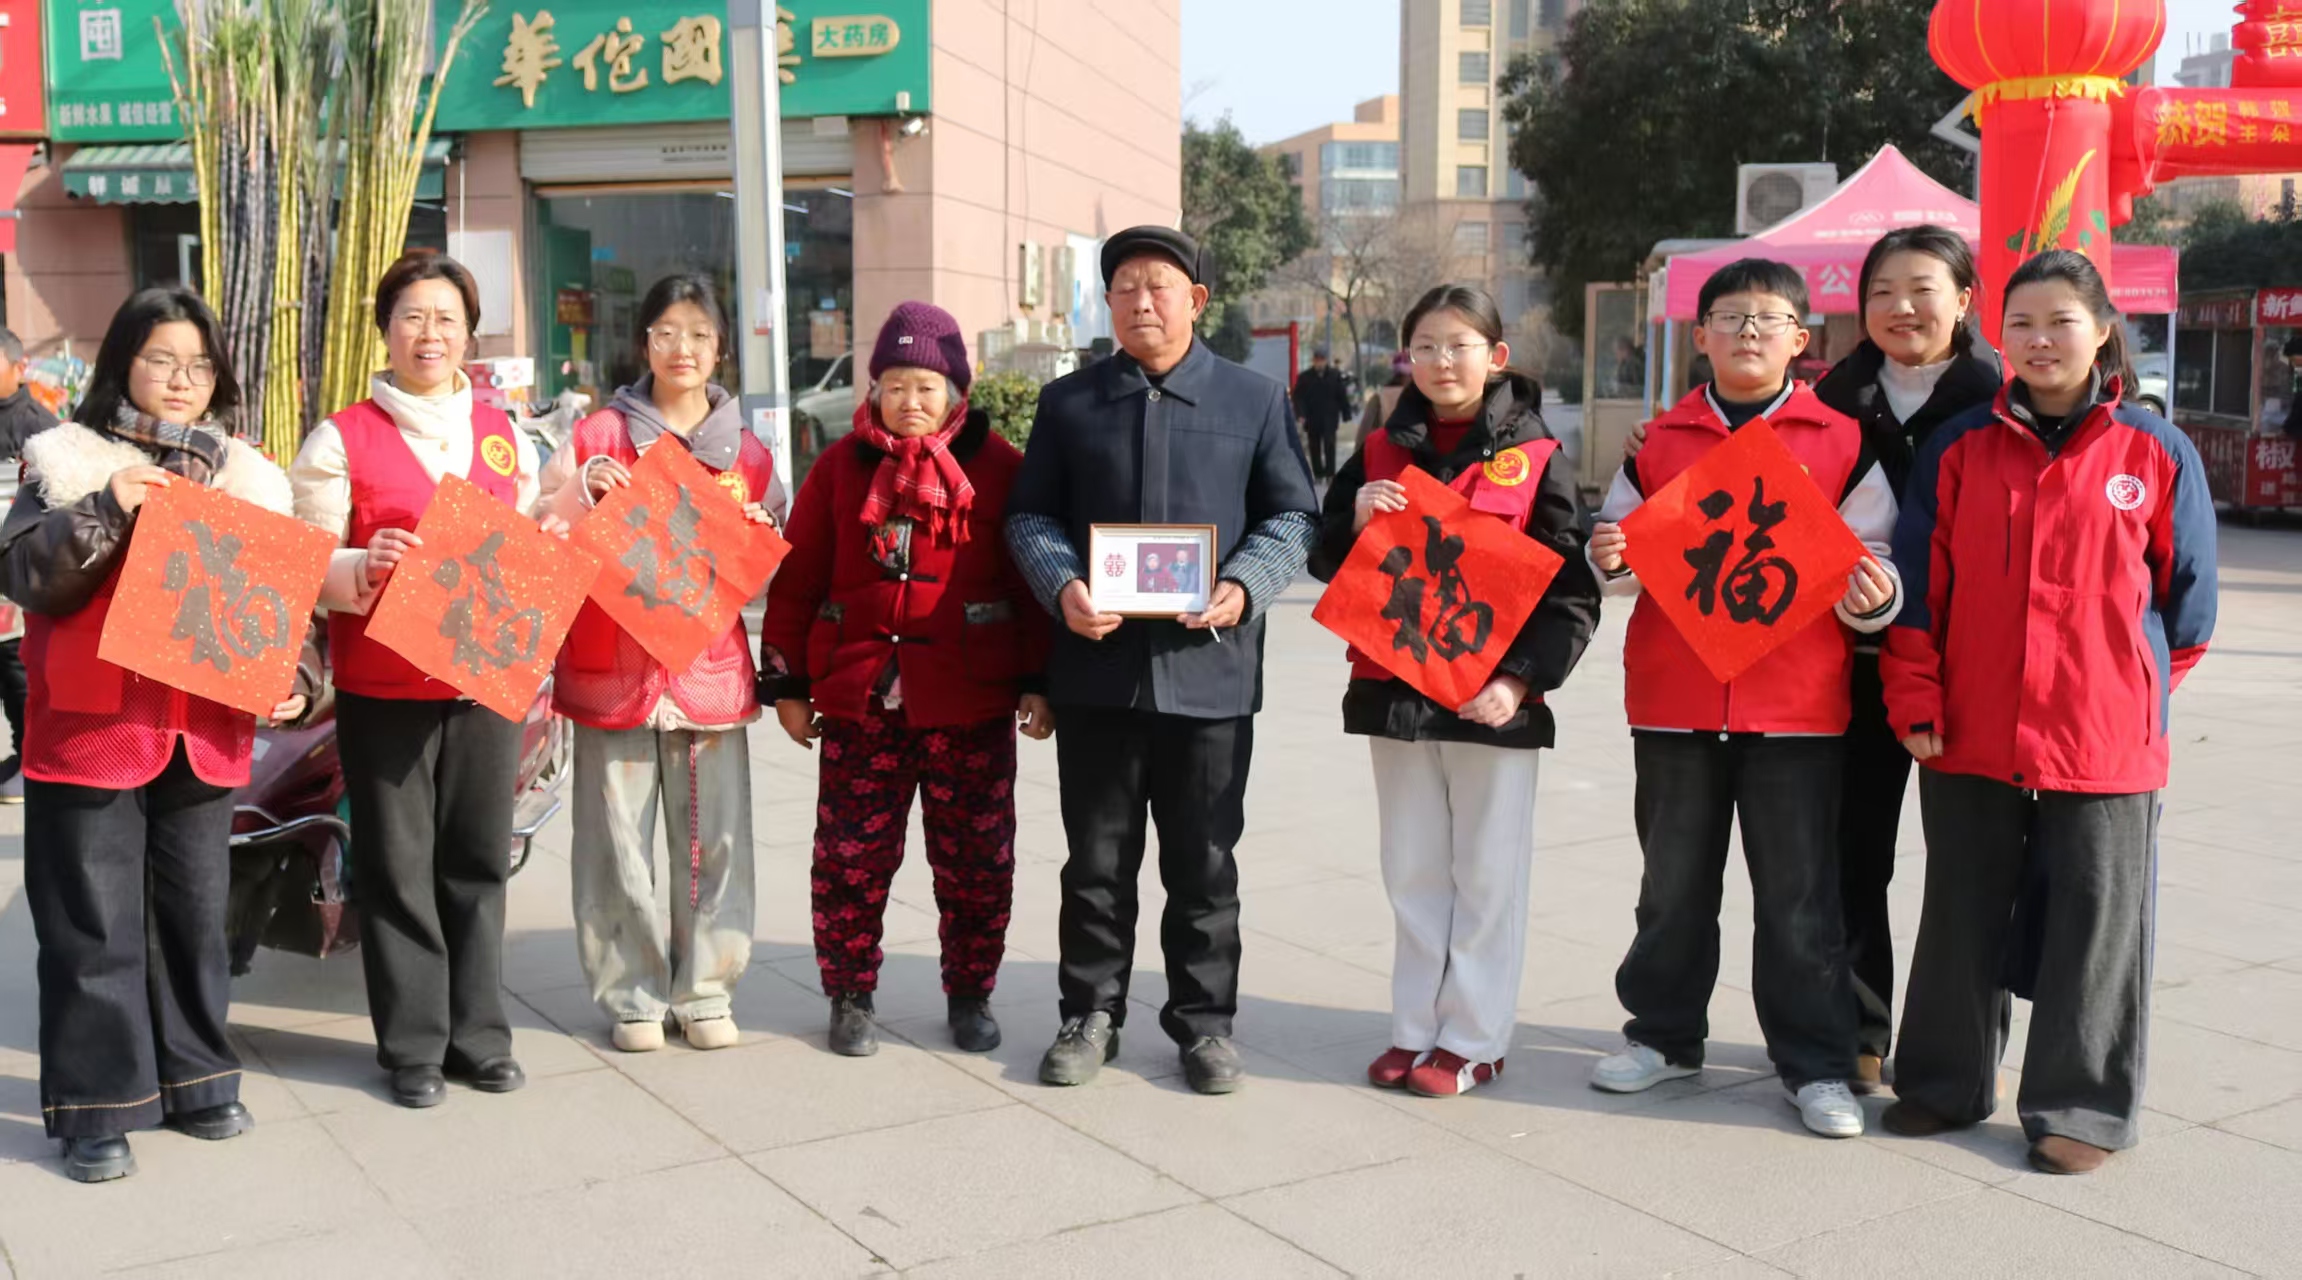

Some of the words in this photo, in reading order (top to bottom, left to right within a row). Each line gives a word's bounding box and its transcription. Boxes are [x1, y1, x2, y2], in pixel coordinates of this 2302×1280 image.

[817, 23, 890, 48] 大药房
[2156, 99, 2228, 147] 恭贺
[620, 484, 716, 617] 福
[1378, 514, 1494, 664] 福
[1683, 475, 1798, 626] 福
